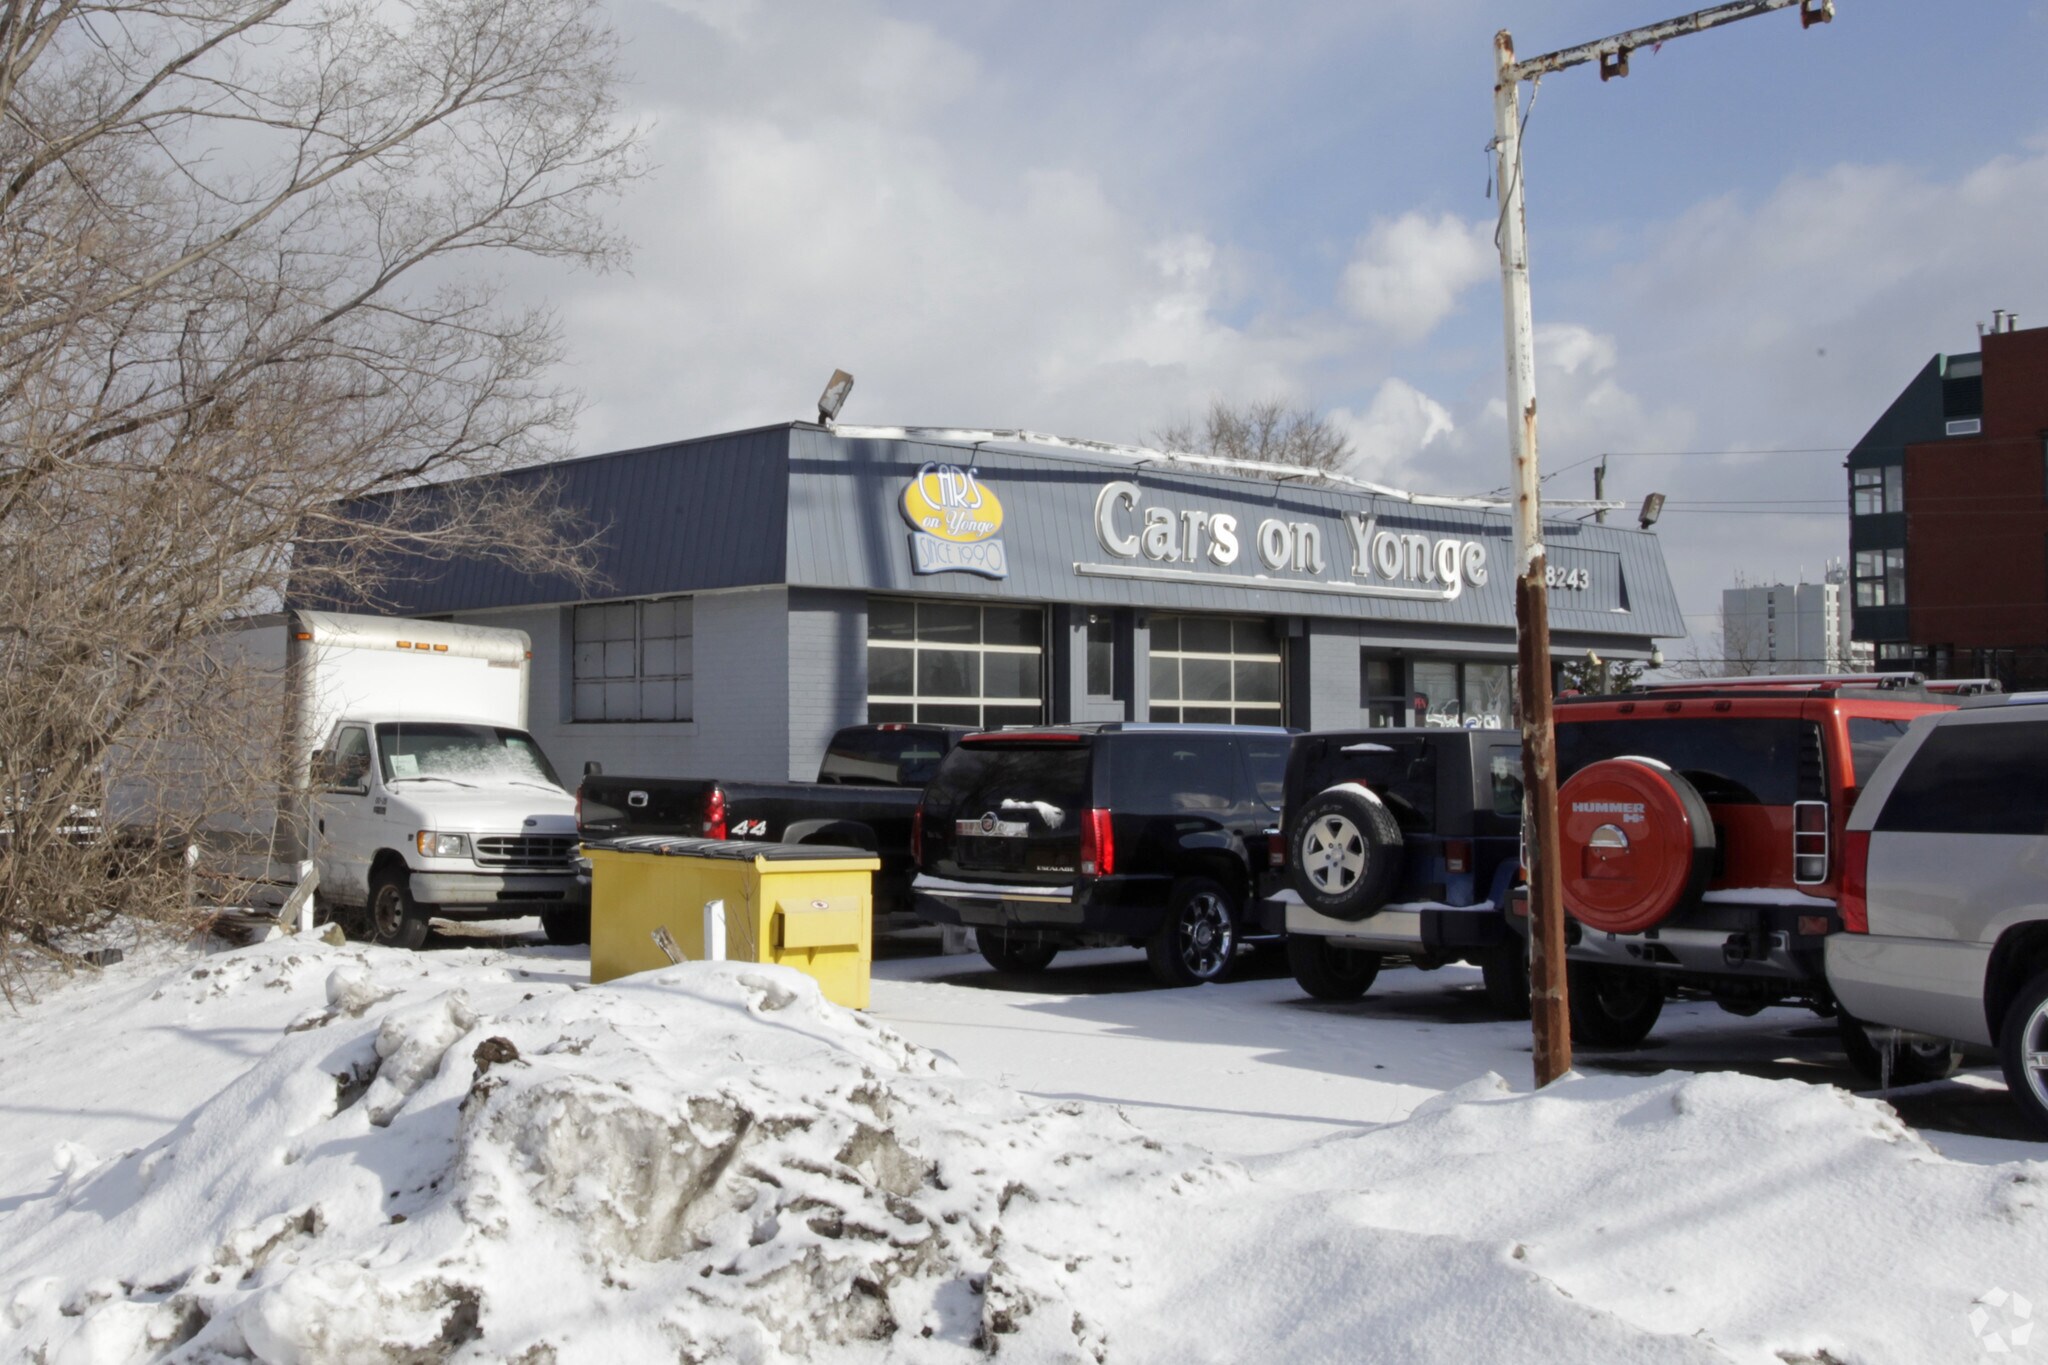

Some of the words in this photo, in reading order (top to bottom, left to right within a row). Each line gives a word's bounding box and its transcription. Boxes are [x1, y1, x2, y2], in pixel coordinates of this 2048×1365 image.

[923, 516, 941, 528] on
[946, 510, 994, 536] Yonge
[1095, 481, 1240, 566] Cars
[1257, 518, 1326, 575] on
[1343, 510, 1488, 600] Yonge
[920, 537, 952, 568] SINCE
[958, 543, 1003, 571] 1990
[1545, 565, 1590, 590] 8243
[1572, 802, 1645, 813] HUMMER
